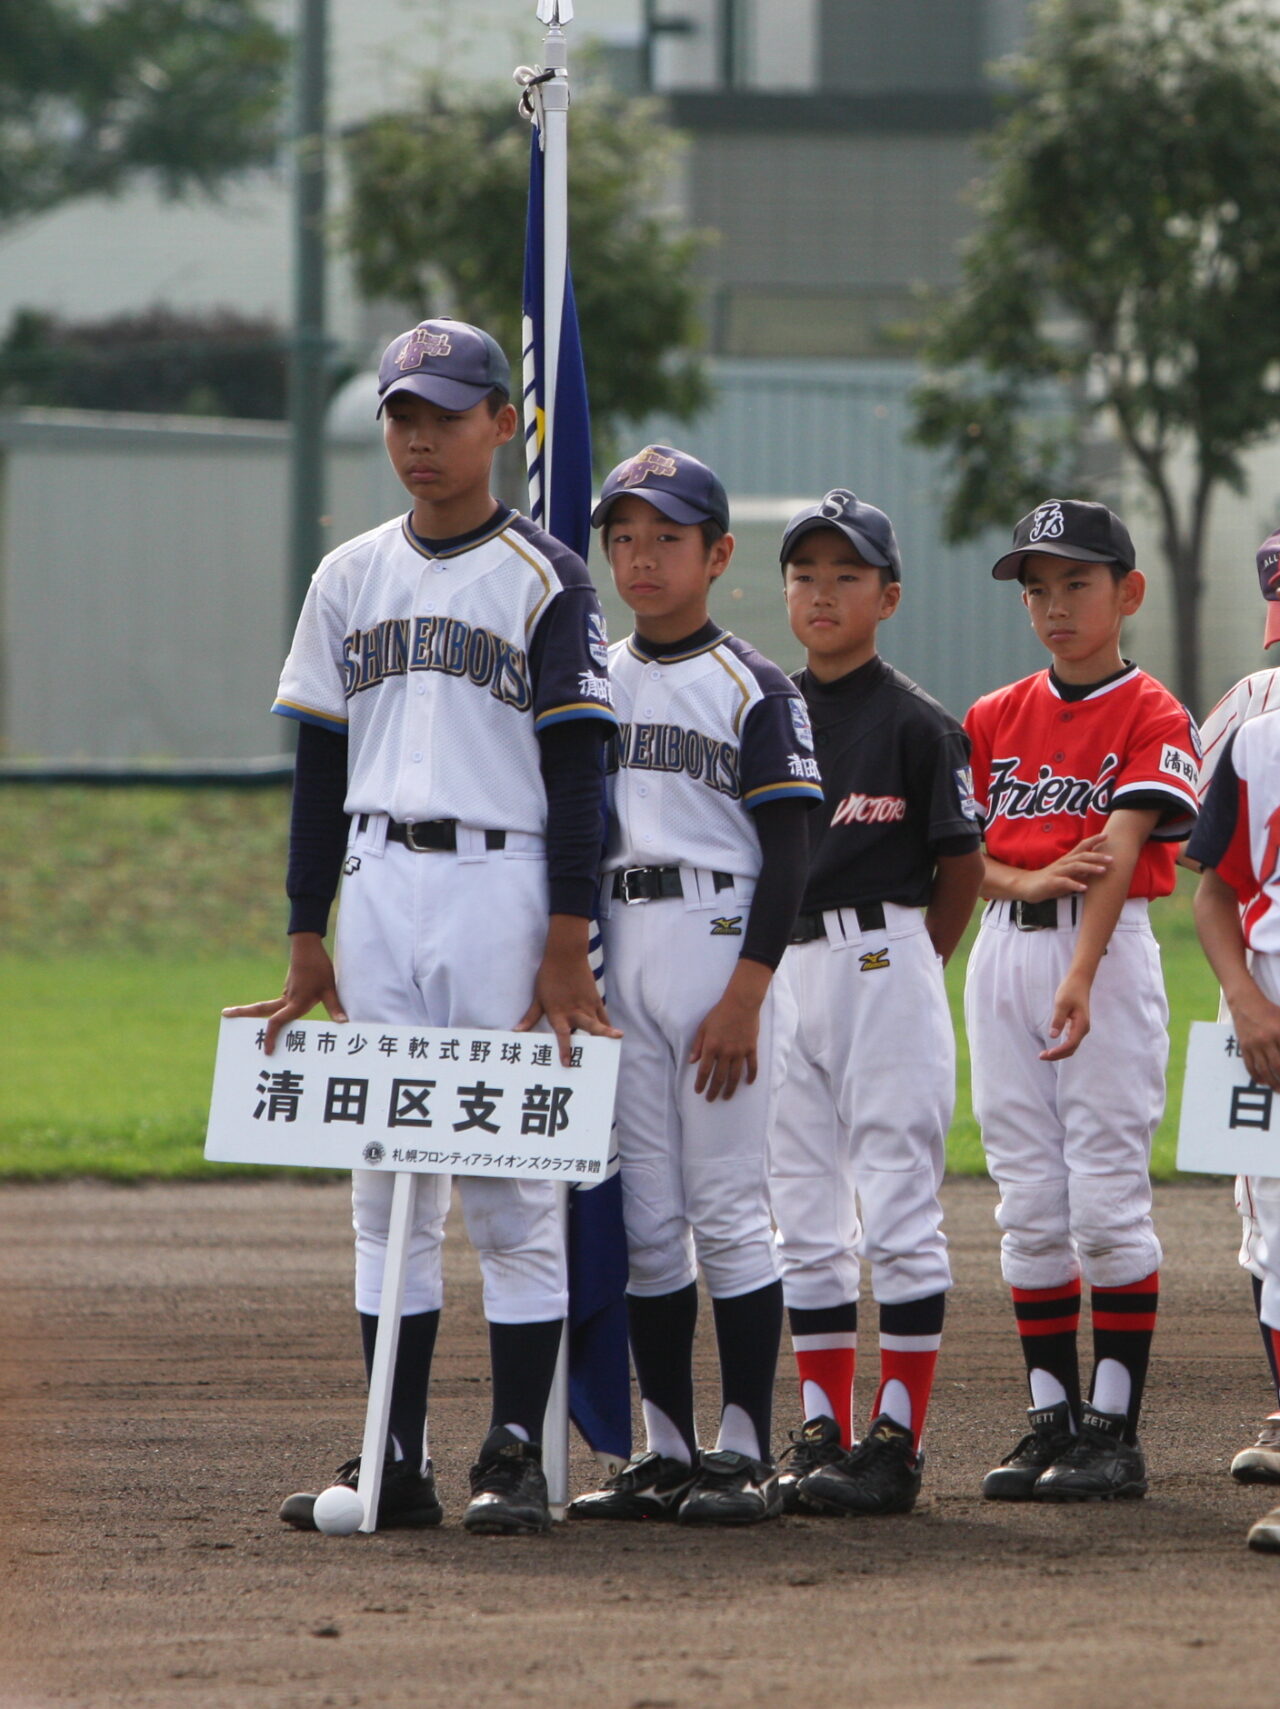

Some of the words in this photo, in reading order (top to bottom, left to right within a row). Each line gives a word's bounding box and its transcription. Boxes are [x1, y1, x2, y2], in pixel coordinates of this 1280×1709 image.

[819, 494, 849, 519] S
[604, 722, 743, 800] NEIBOYS
[252, 1069, 574, 1138] 清田区支部
